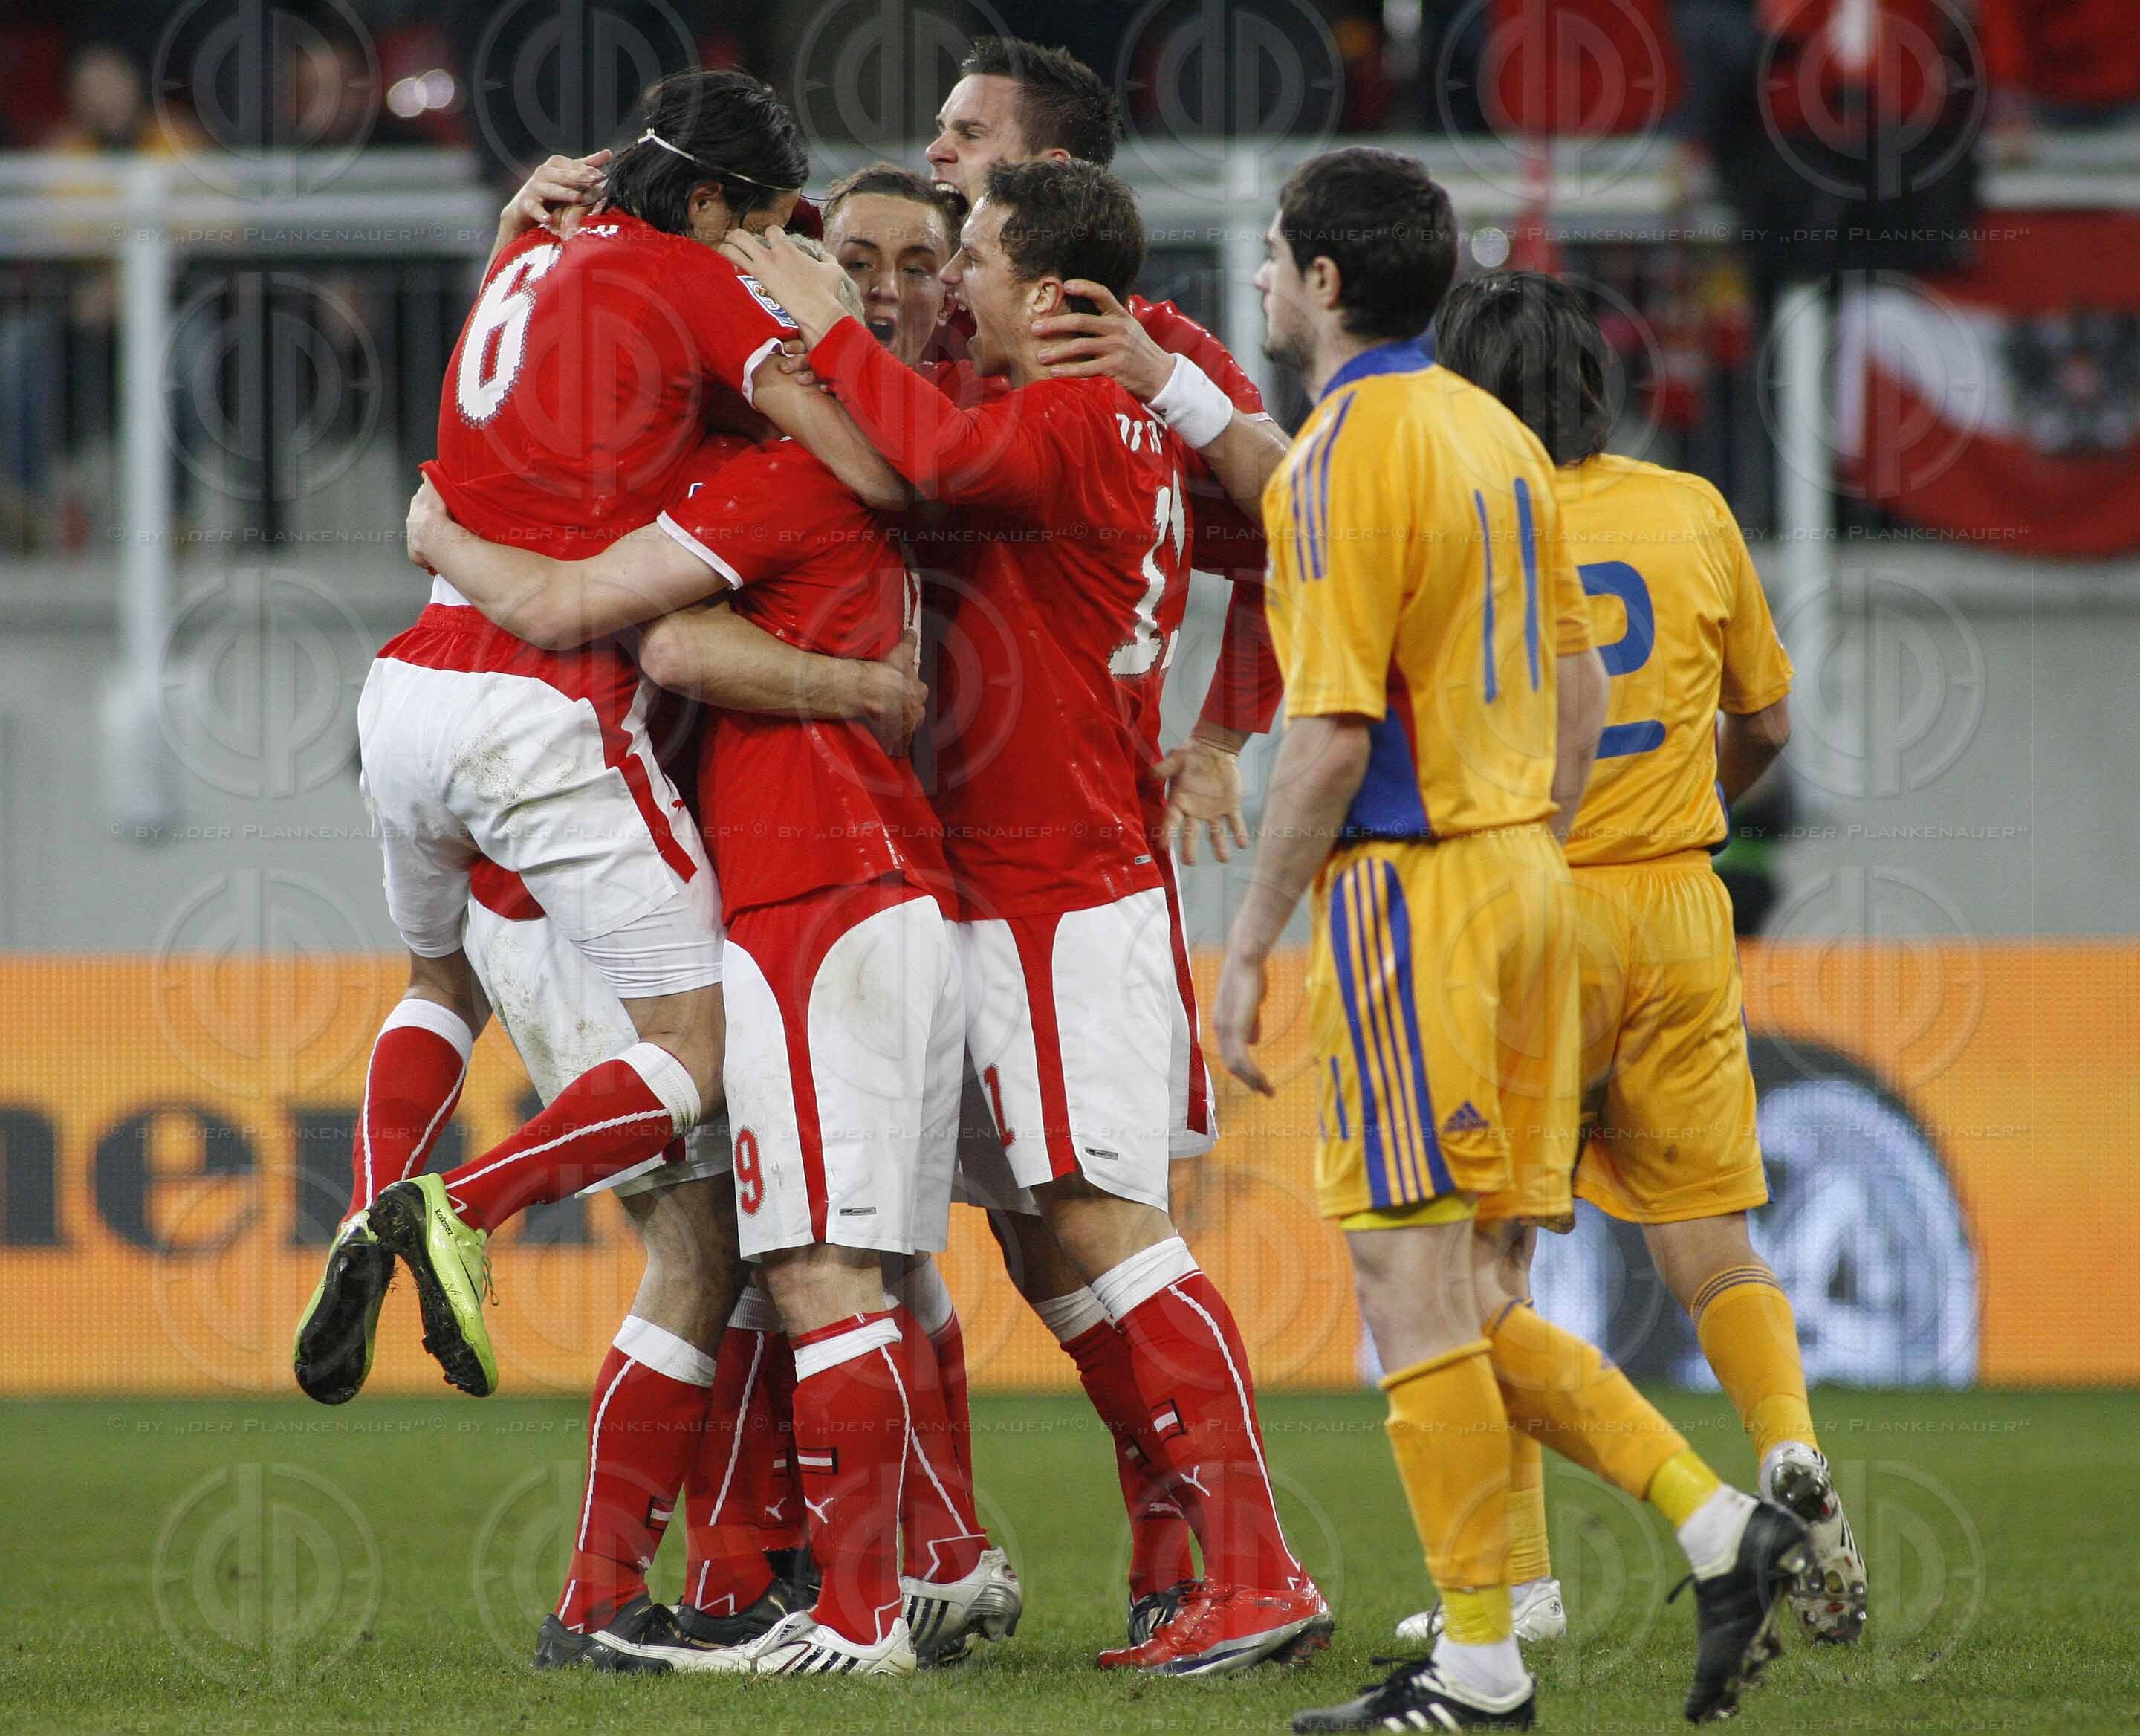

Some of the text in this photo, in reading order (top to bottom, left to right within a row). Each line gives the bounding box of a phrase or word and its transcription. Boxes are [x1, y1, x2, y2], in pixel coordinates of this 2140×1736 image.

[455, 244, 563, 428] 6
[1473, 477, 1540, 705] 11
[1577, 560, 1667, 760] 2
[734, 1124, 766, 1219] 9
